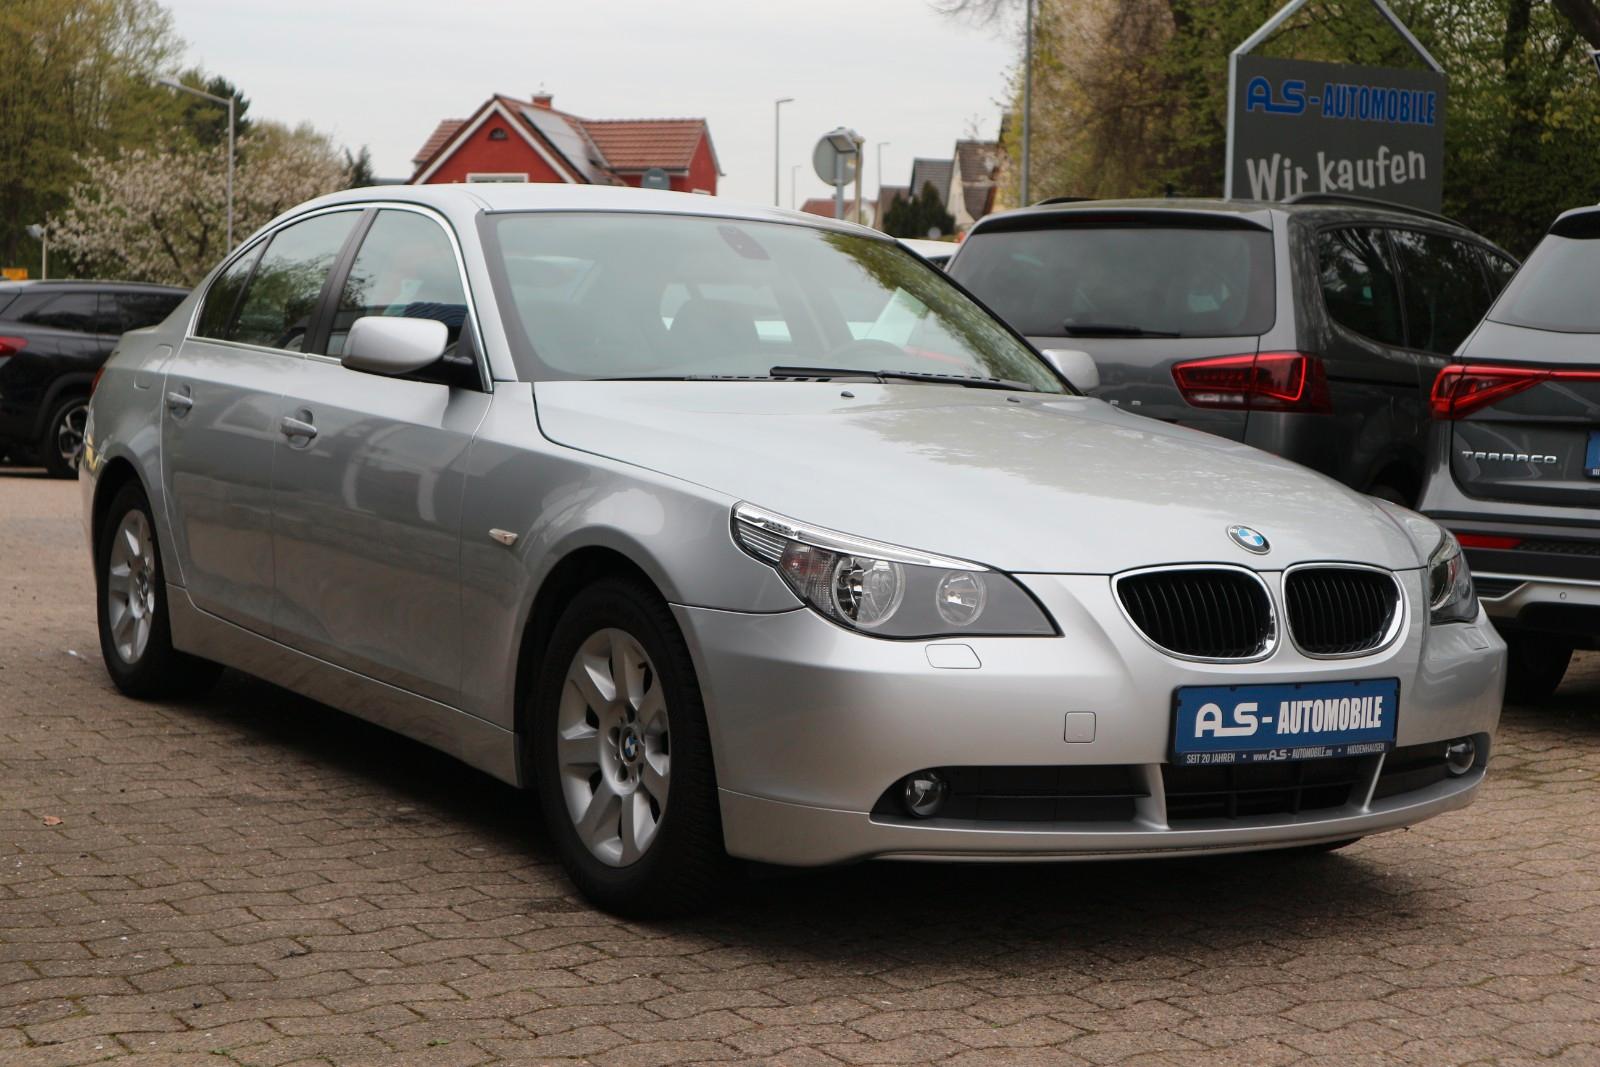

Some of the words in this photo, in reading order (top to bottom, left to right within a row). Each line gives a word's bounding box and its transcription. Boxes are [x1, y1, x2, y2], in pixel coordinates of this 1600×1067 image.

[1246, 153, 1308, 201] Wir
[1317, 145, 1427, 194] kaufen
[1462, 451, 1557, 464] TARRACO
[1186, 753, 1200, 764] SEIT
[1201, 753, 1211, 764] 20
[1211, 752, 1236, 764] JAHREN
